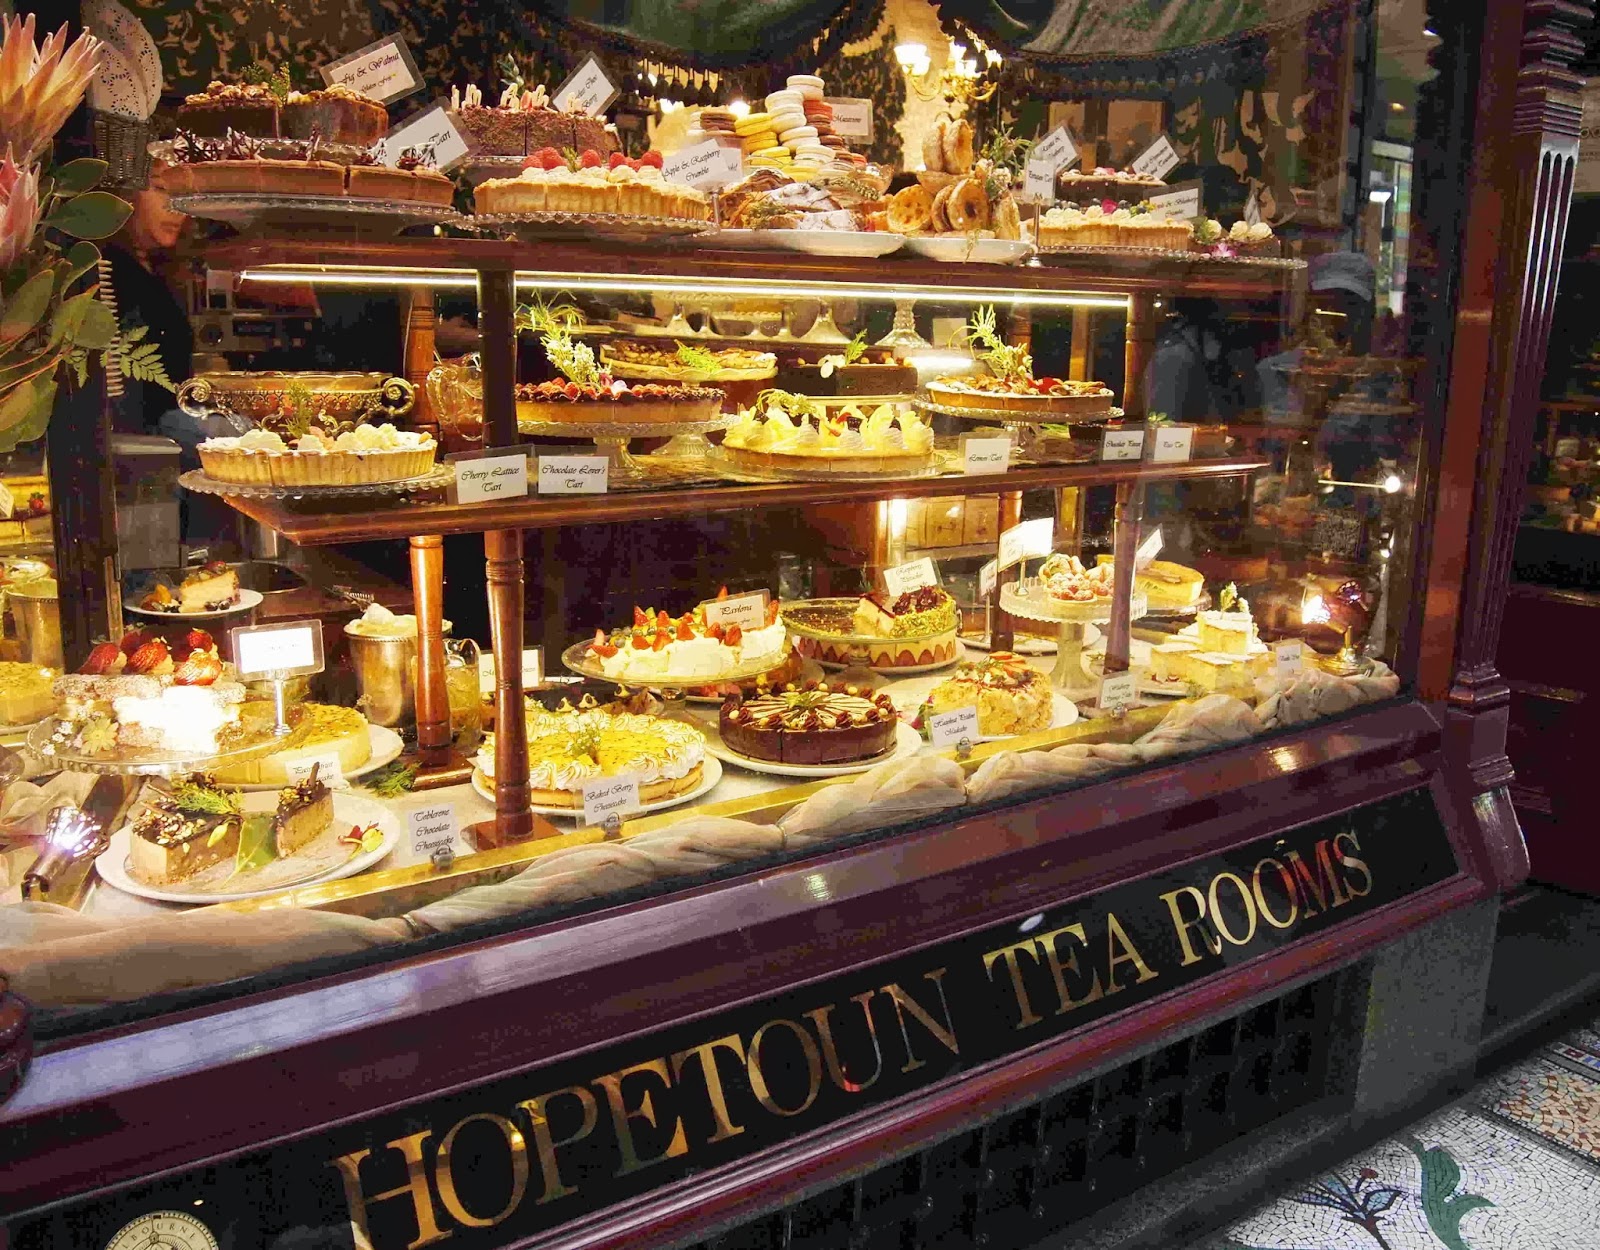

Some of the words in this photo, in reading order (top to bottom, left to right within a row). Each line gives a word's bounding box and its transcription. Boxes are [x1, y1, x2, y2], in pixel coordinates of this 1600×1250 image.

[356, 67, 368, 78] &
[662, 164, 680, 182] Apple
[681, 160, 690, 170] &
[690, 149, 721, 166] Raspberry
[685, 166, 710, 182] Crumble
[968, 453, 988, 463] Lemon
[989, 453, 1003, 462] Tart
[461, 470, 489, 481] Cherry
[490, 466, 520, 477] Lattice
[541, 464, 578, 475] Chocolate
[578, 464, 606, 475] Lover's
[481, 481, 502, 493] Tart
[564, 478, 585, 489] Tart
[720, 604, 753, 616] Pavlova
[584, 788, 610, 802] Baked
[610, 783, 634, 795] Berry
[593, 796, 628, 813] Cheesecake
[413, 809, 450, 822] Toblerone
[416, 822, 451, 837] Chocolate
[414, 835, 455, 851] Cheesecake
[324, 967, 961, 1250] HOPETOUN
[983, 912, 1159, 1031] TEA
[1159, 829, 1374, 968] ROOMS
